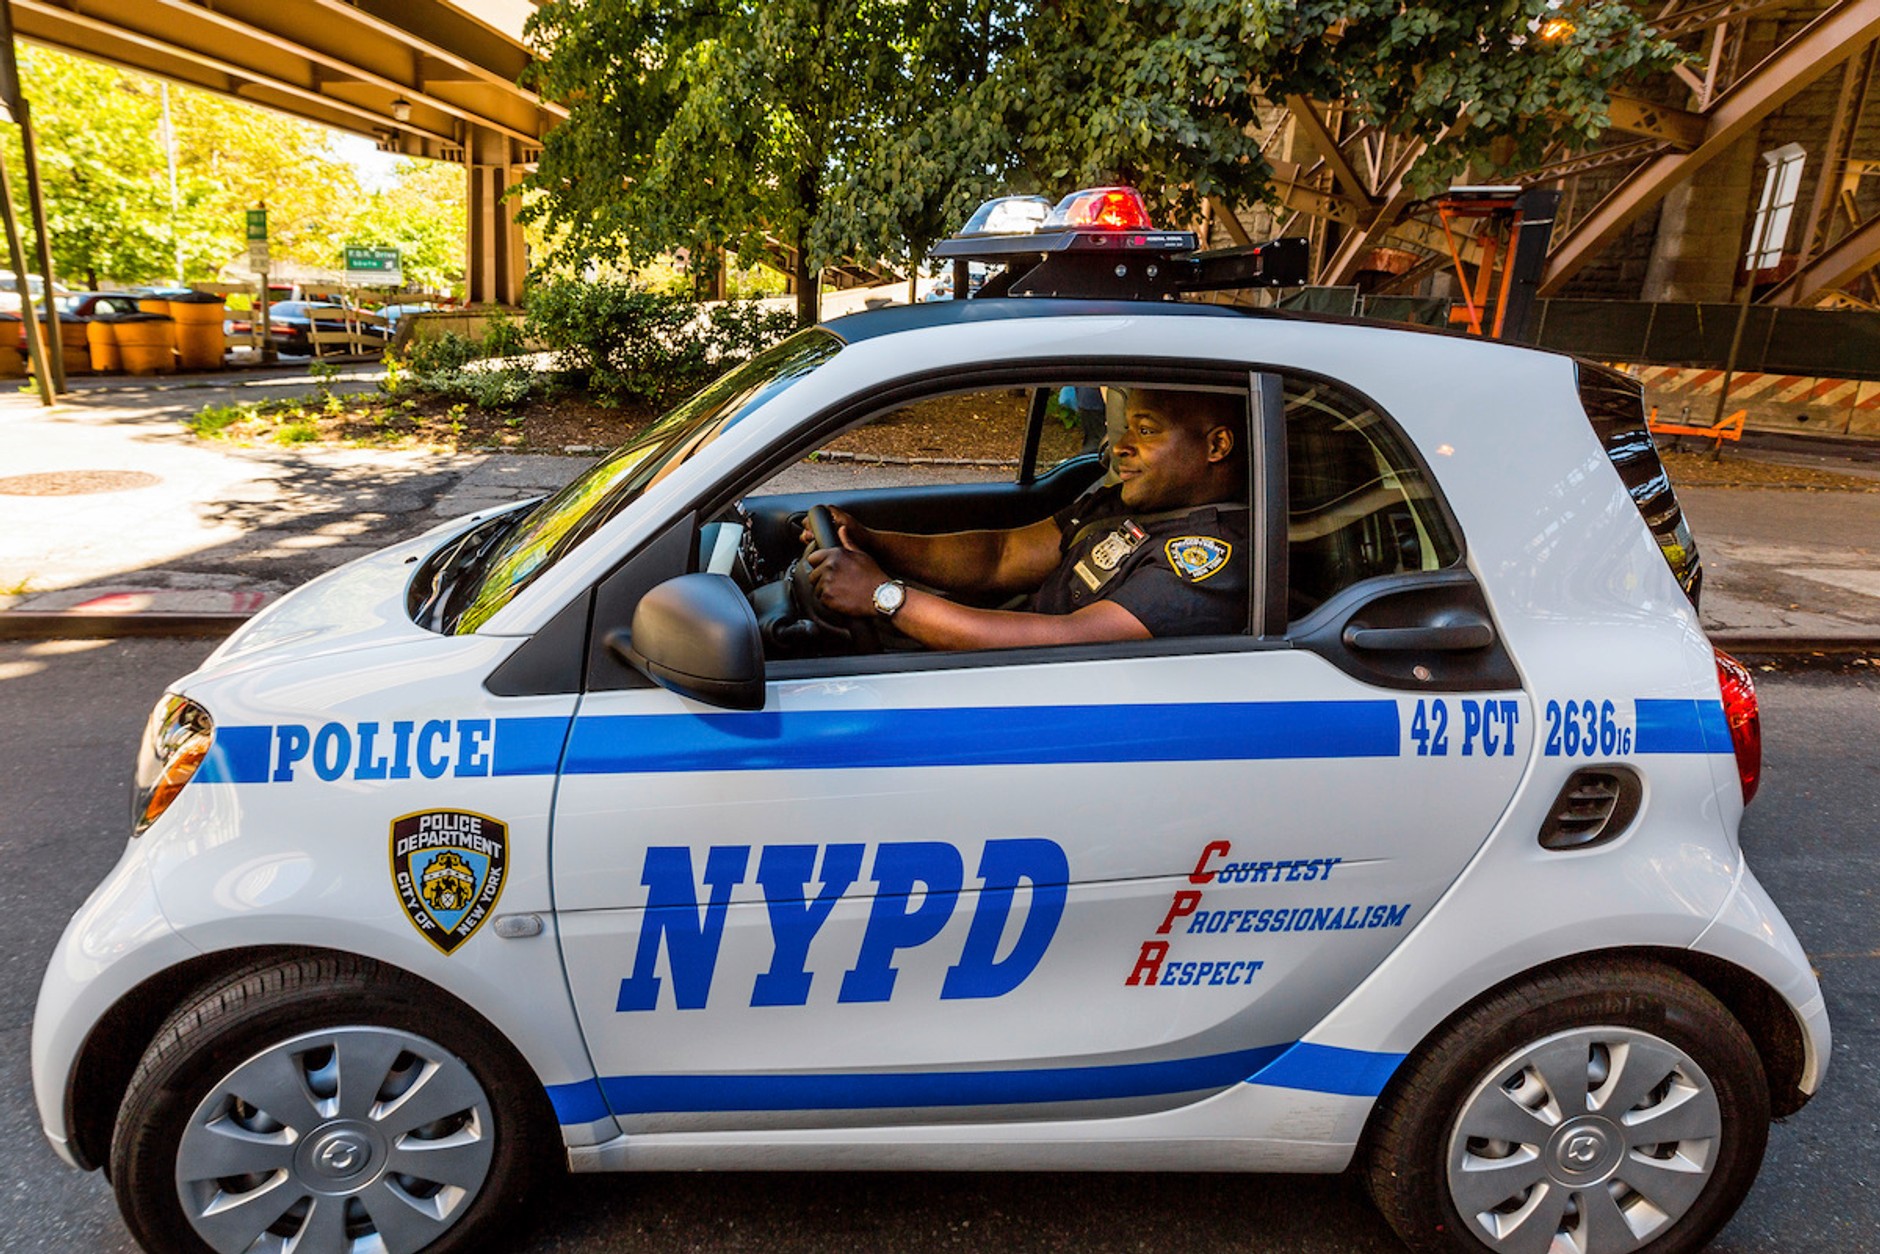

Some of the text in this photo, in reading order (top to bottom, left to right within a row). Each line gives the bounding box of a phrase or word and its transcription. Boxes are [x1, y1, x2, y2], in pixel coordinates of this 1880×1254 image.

[273, 719, 491, 782] POLICE
[1410, 699, 1448, 756] 42
[1461, 699, 1519, 756] PCT
[397, 831, 502, 858] DEPARTMENT
[420, 813, 482, 835] POLICE
[397, 872, 436, 930] CITY OF
[457, 866, 502, 936] NEW YORK
[615, 838, 1070, 1013] NYPD
